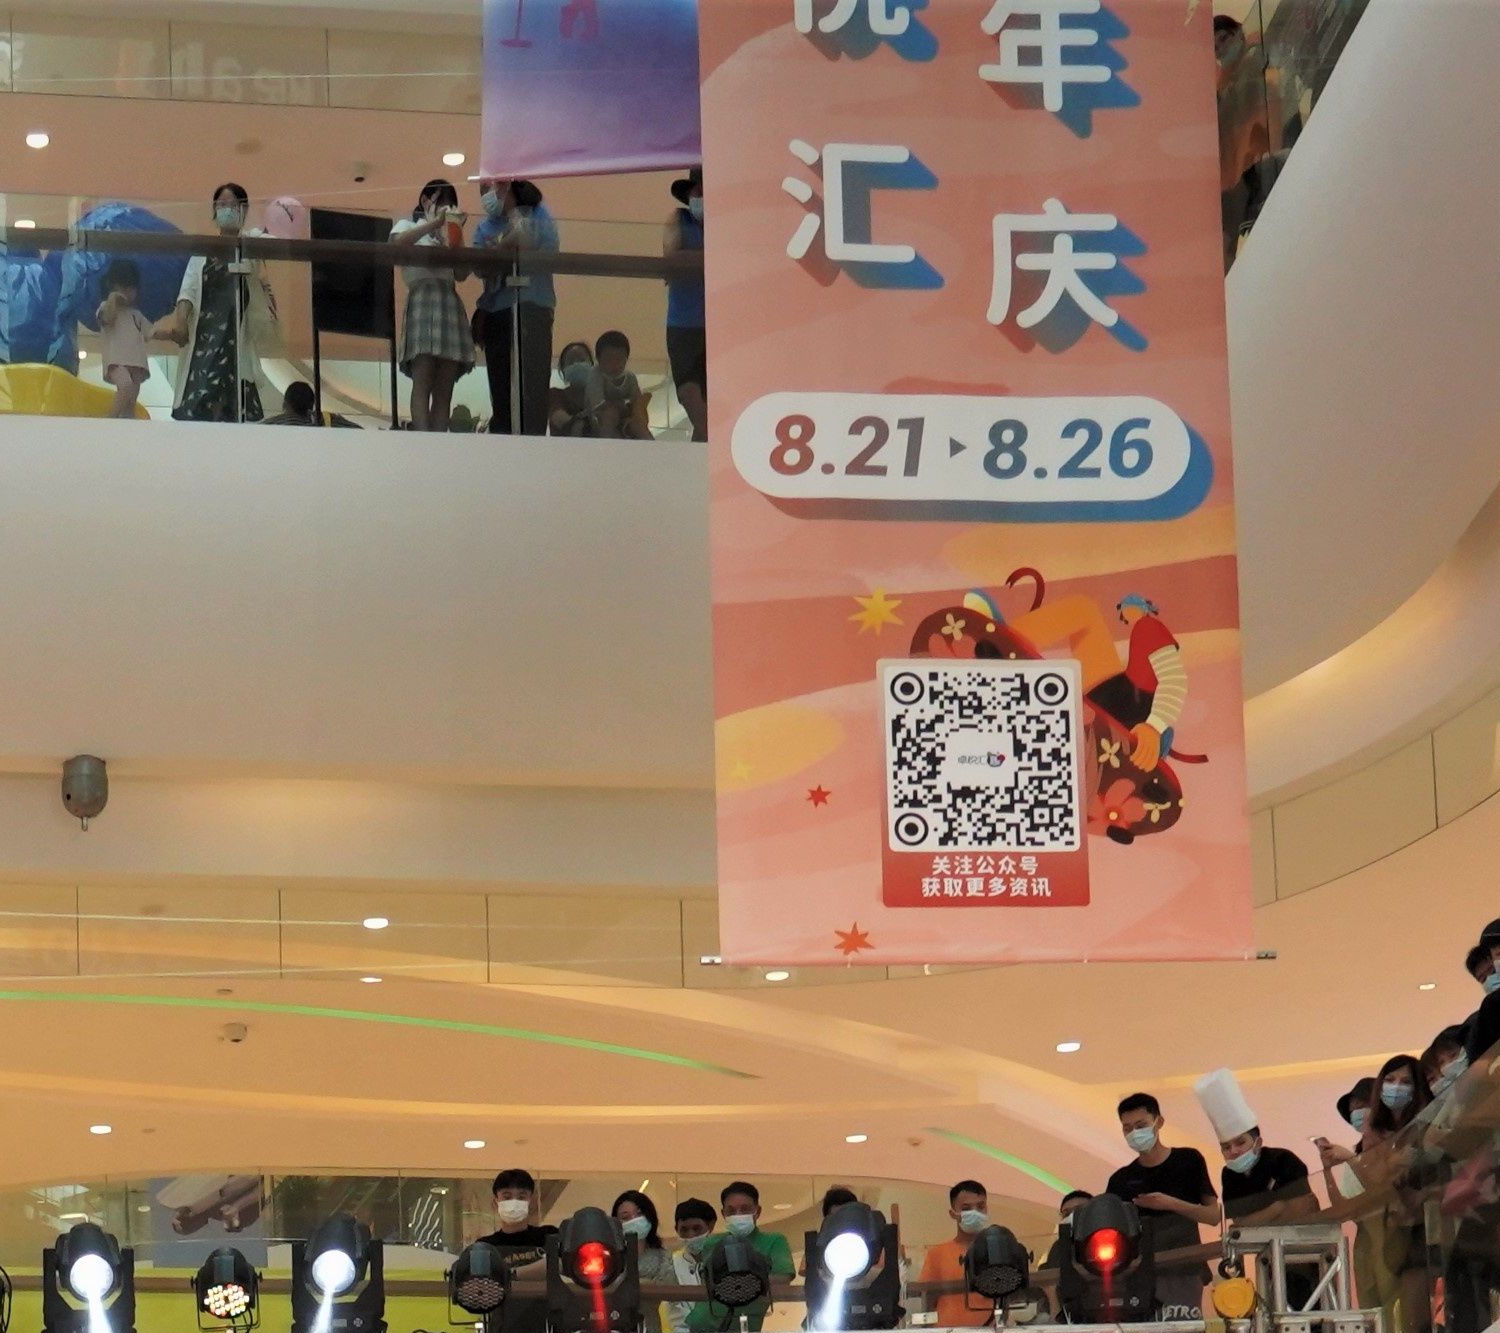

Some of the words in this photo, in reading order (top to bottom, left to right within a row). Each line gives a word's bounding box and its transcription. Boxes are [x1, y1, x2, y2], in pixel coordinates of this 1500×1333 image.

[767, 414, 925, 479] 8.21
[982, 416, 1155, 481] 8.26
[931, 855, 1039, 875] 关注公众号
[921, 877, 1052, 897] 获取更多资讯
